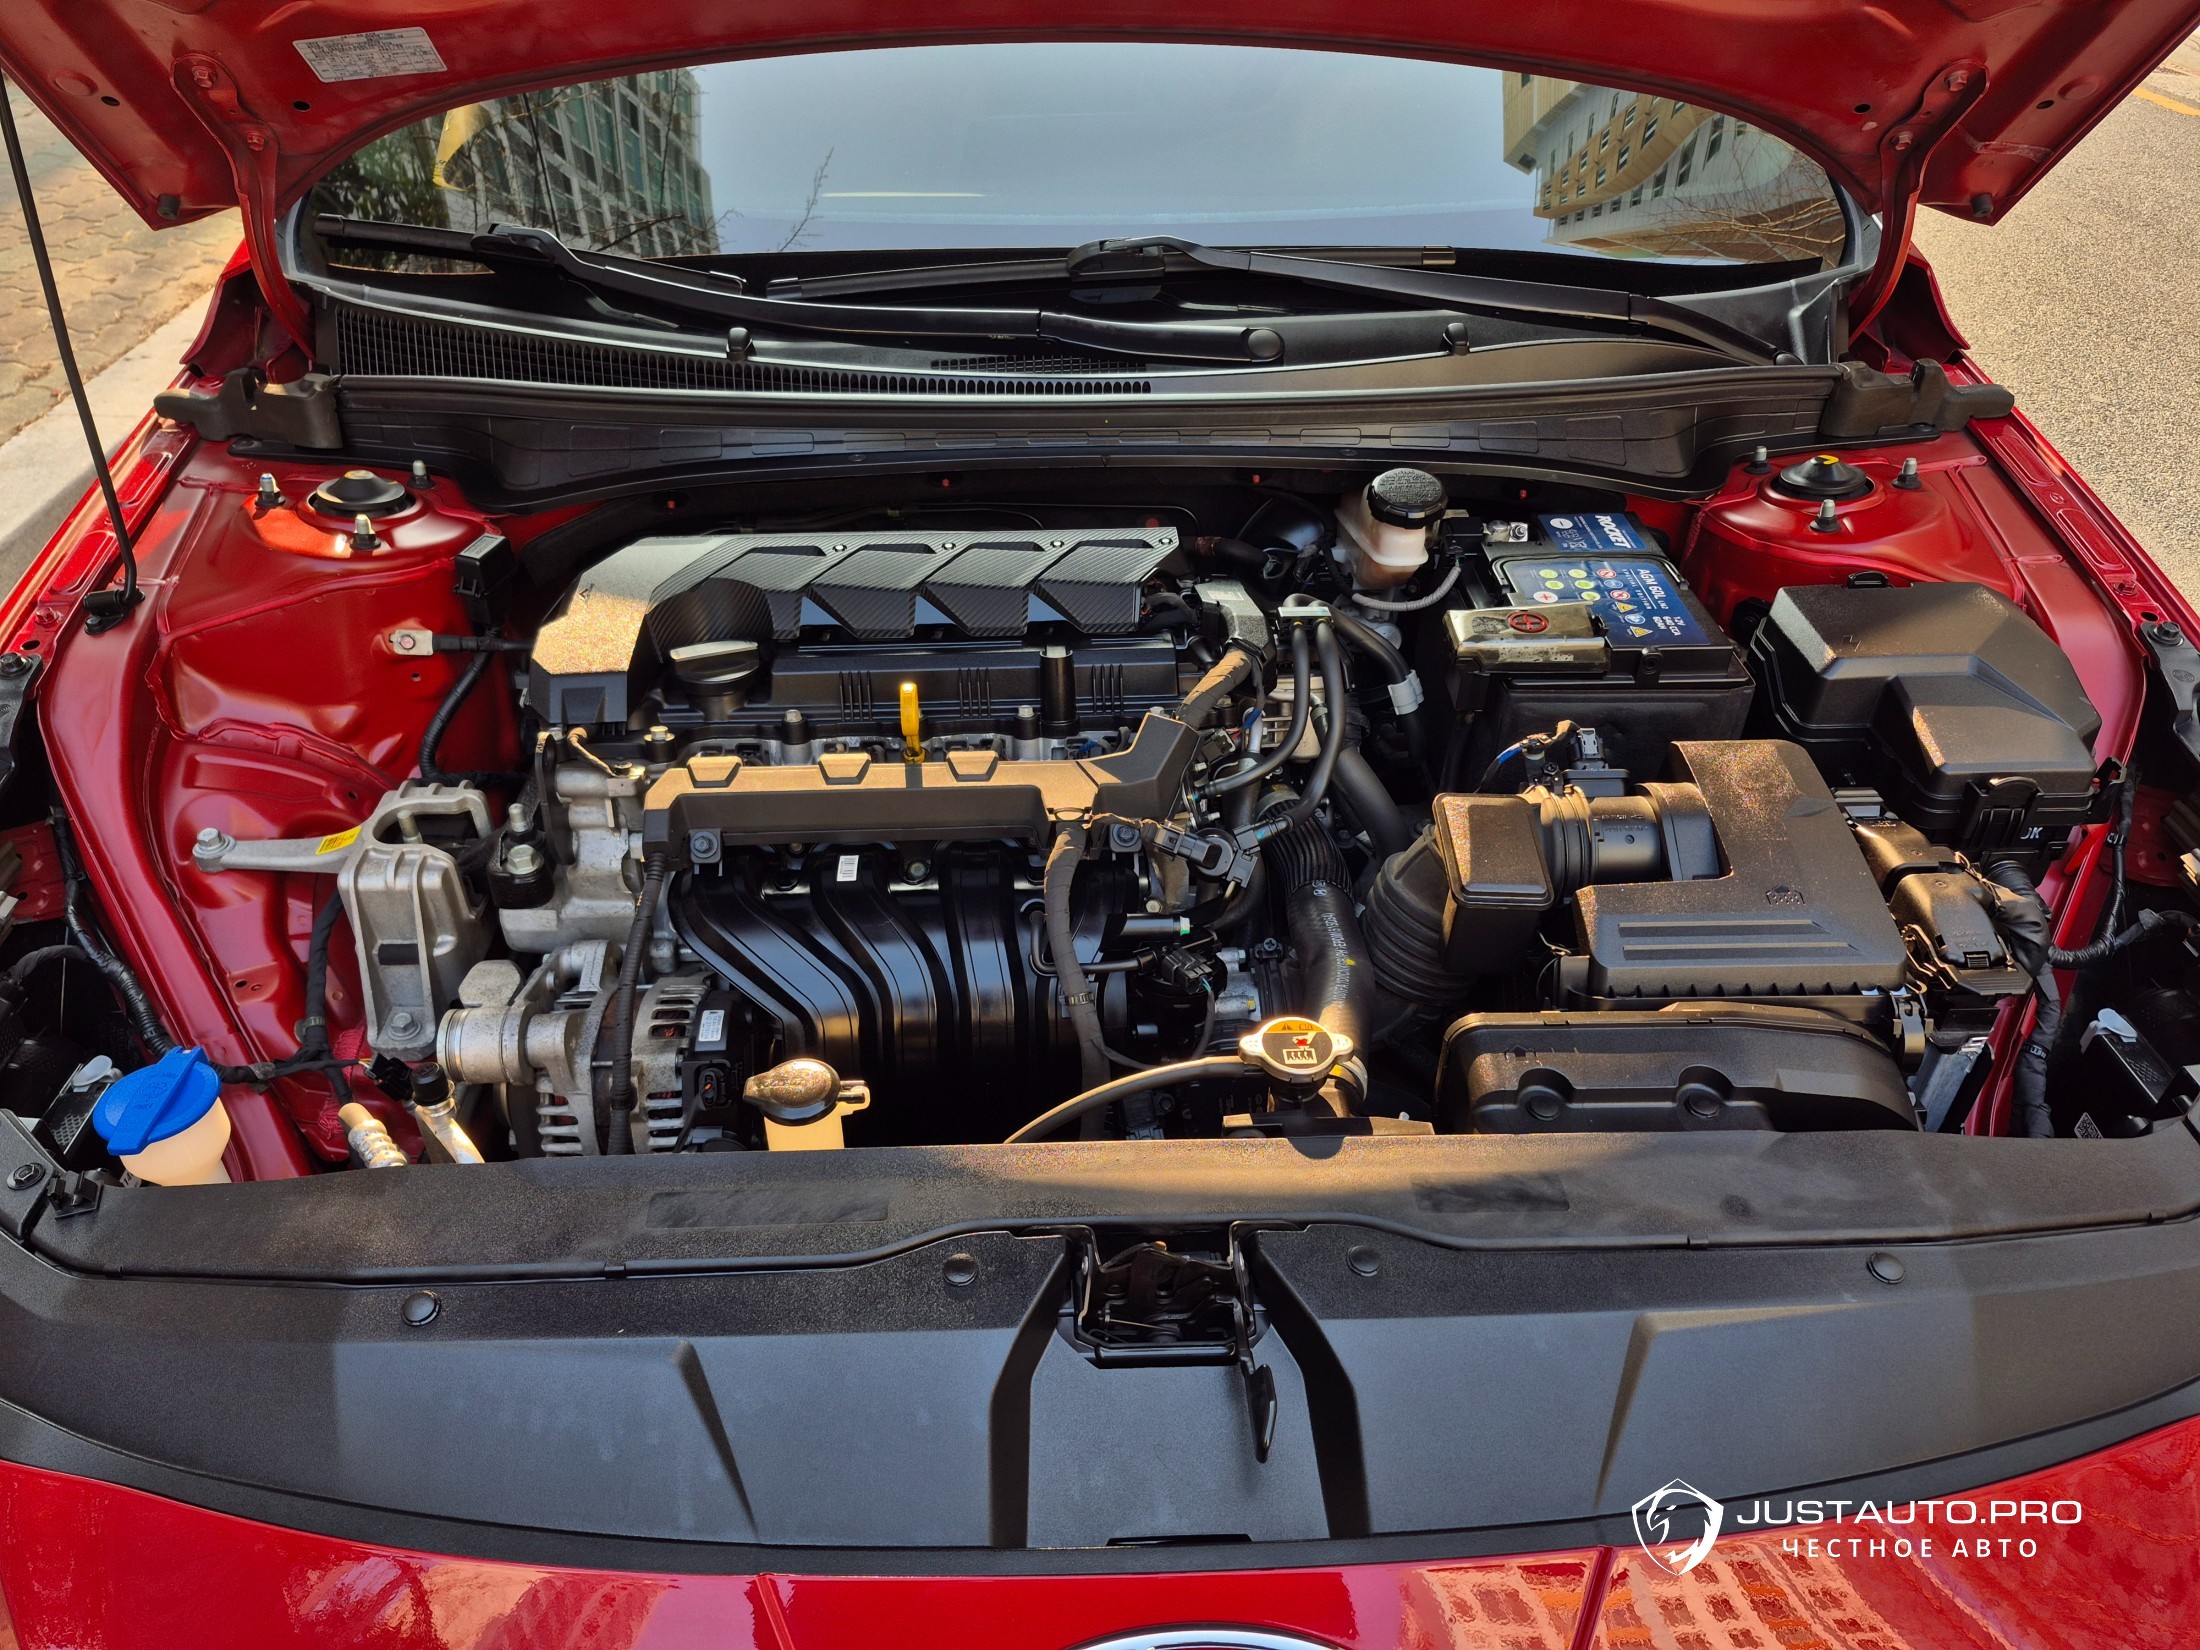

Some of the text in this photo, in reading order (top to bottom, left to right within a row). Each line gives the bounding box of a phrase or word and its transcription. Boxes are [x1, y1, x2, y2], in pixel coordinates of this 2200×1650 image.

[1595, 515, 1632, 549] ROCKET
[1622, 568, 1638, 588] SPECIAL
[1635, 589, 1653, 610] EDITION
[1637, 568, 1658, 585] AGM
[1648, 586, 1667, 600] 60L
